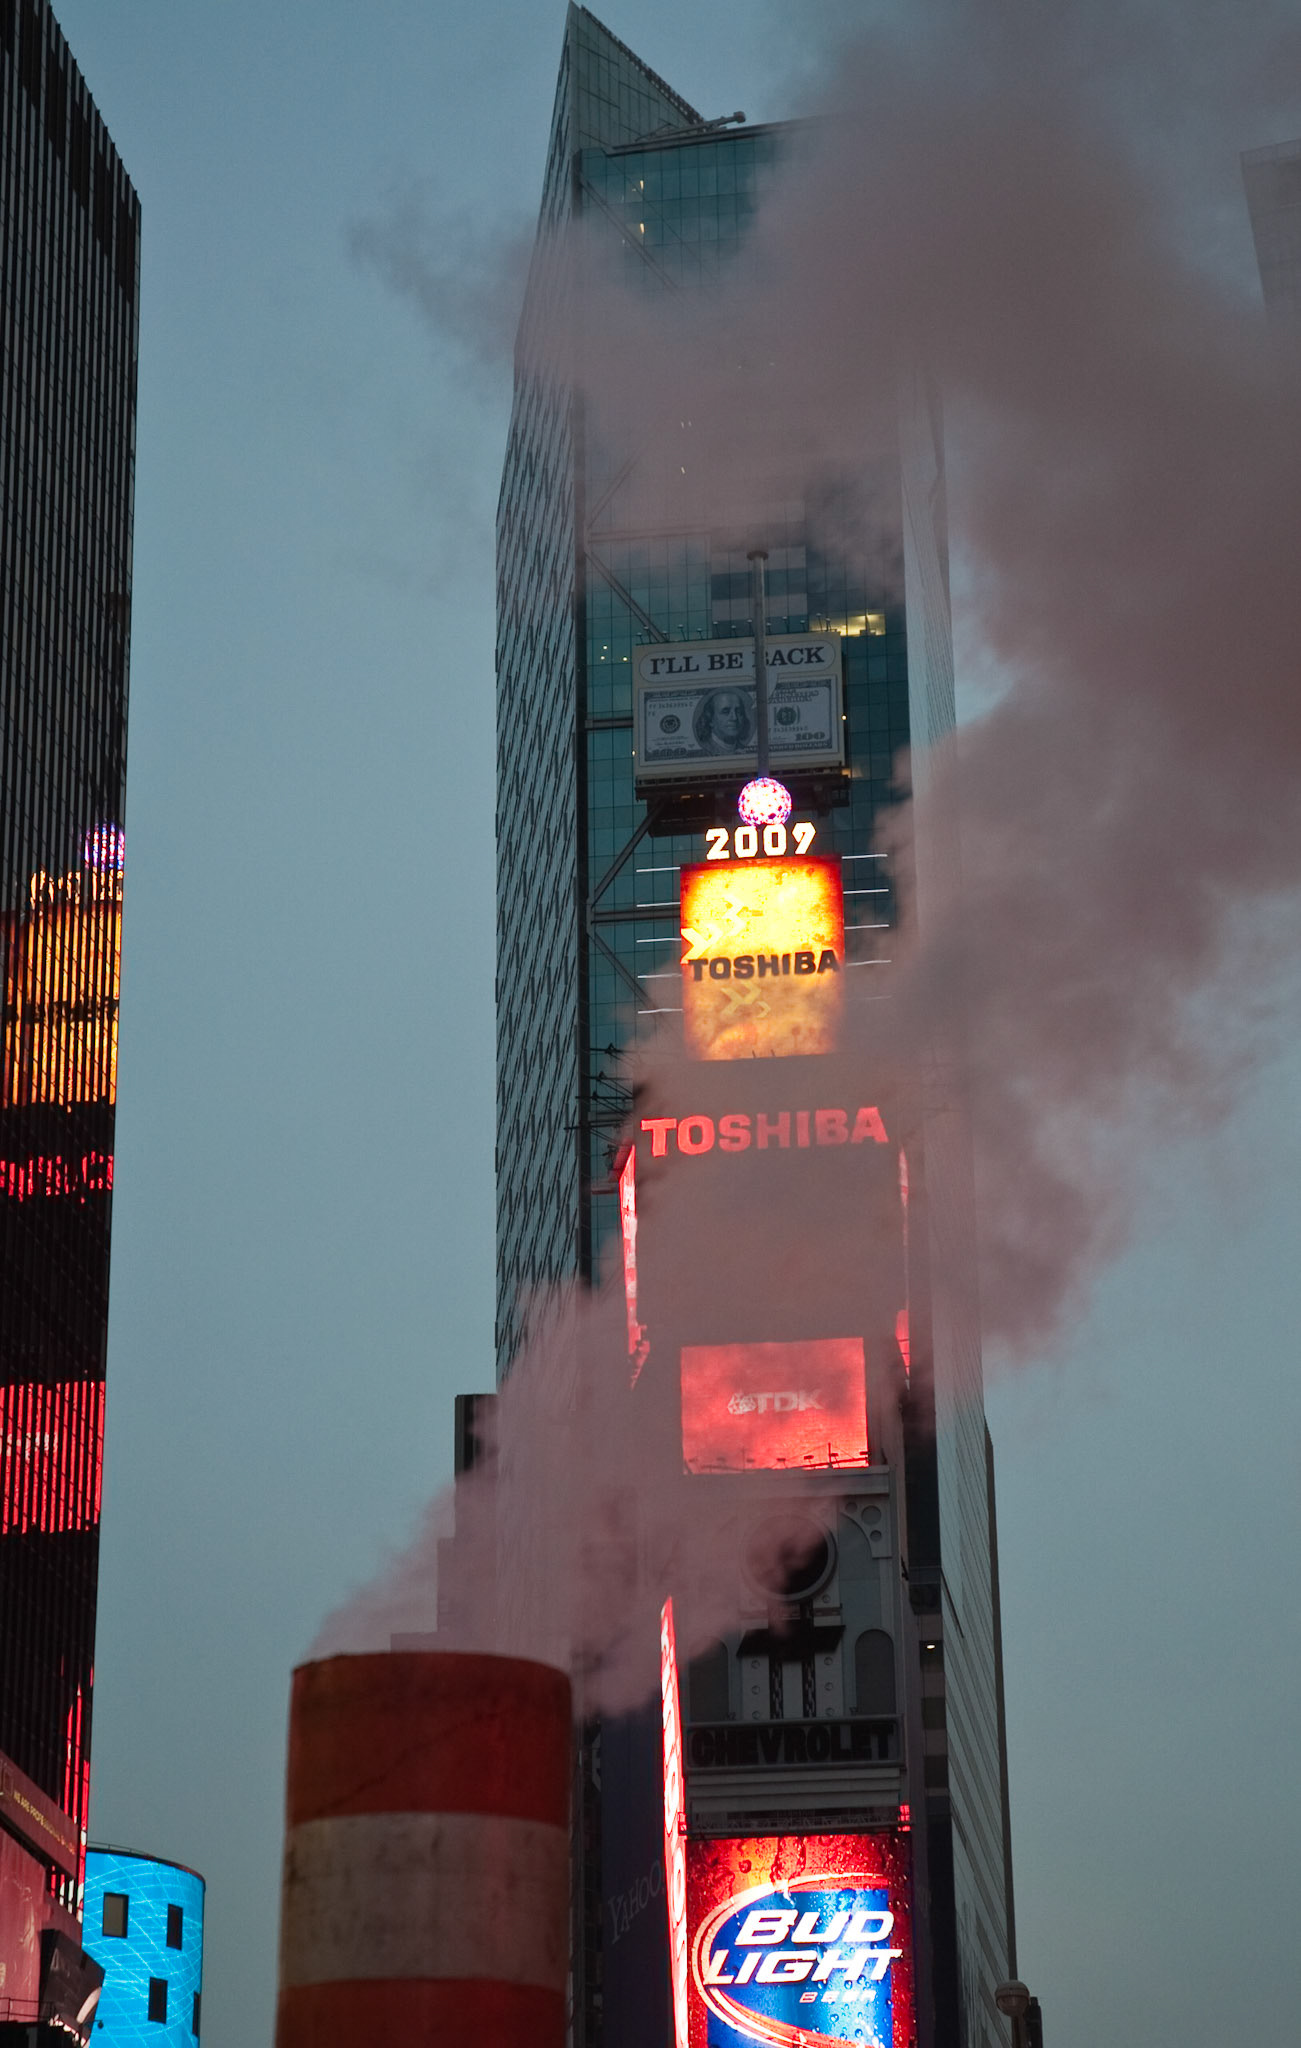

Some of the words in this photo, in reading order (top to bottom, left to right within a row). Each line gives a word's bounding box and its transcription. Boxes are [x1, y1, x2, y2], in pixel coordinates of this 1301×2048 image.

[650, 656, 700, 675] I'LL
[708, 652, 743, 671] BE
[795, 731, 826, 741] 100
[705, 821, 817, 860] 2009
[688, 949, 840, 982] TOSHIBA
[640, 1106, 889, 1157] TOSHIBA
[751, 1389, 824, 1414] TDK
[691, 1722, 895, 1767] CHEVROLET
[735, 1909, 894, 1946] BUD
[703, 1948, 903, 1986] LIGHT
